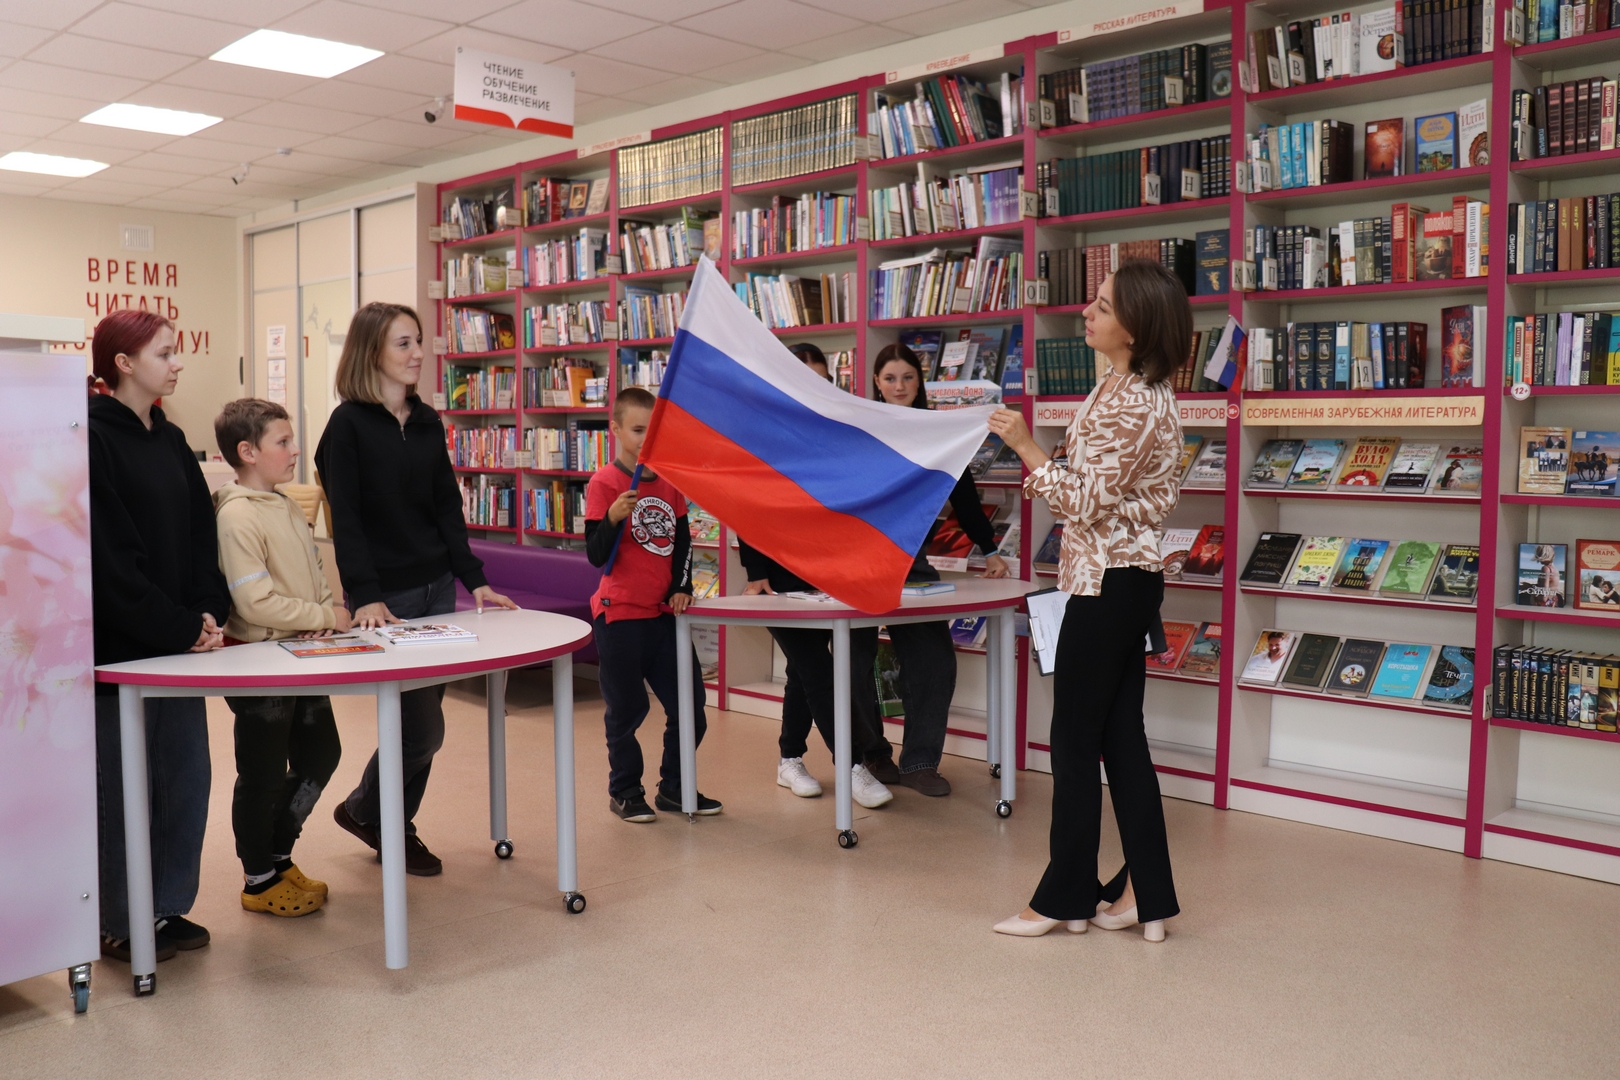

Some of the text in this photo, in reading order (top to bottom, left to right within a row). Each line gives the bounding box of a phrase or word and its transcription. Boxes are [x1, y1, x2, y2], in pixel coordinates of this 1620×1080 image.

[1093, 6, 1177, 32] РУССКАЯ ЛИТЕРАТУРА
[1515, 15, 1521, 34] Б
[926, 53, 971, 71] КРАЕВЕДЕНИЕ
[1293, 60, 1301, 76] В
[484, 62, 524, 79] ЧТЕНИЕ
[1242, 71, 1249, 86] А
[1272, 64, 1279, 80] Б
[483, 76, 538, 96] ОБУЧЕНИЕ
[1168, 83, 1178, 100] Д
[482, 89, 551, 111] РАЗВЛЕЧЕНИЕ
[1028, 108, 1036, 123] Б
[1044, 105, 1053, 120] В
[1461, 112, 1485, 127] Идти
[1238, 170, 1244, 185] З
[1260, 167, 1269, 183] И
[1148, 182, 1159, 199] М
[1184, 176, 1194, 192] Н
[1025, 197, 1034, 212] К
[87, 258, 178, 287] ВРЕМЯ
[1235, 267, 1242, 283] К
[1247, 267, 1256, 284] М
[1027, 283, 1036, 299] О
[1039, 285, 1047, 299] П
[86, 292, 179, 320] ЧИТАТЬ
[1027, 375, 1035, 389] Т
[1262, 368, 1272, 384] Ш
[1363, 366, 1370, 382] Я
[934, 388, 961, 397] истока
[1514, 387, 1528, 395] 12+
[1180, 408, 1226, 420] ВТОРОВ
[1246, 406, 1477, 420] СОВРЕМЕННАЯ ЗАРУБЕЖНАЯ ЛИТЕРАТУРА
[1356, 445, 1390, 455] ВУЛФ
[1351, 454, 1387, 465] ХОЛЛ,
[643, 498, 673, 513] THROTTLE
[1165, 534, 1193, 542] Идти
[1387, 663, 1419, 671] КОРОТЫШКА
[1443, 670, 1472, 680] ТЕЧЕТ
[1485, 694, 1492, 712] К
